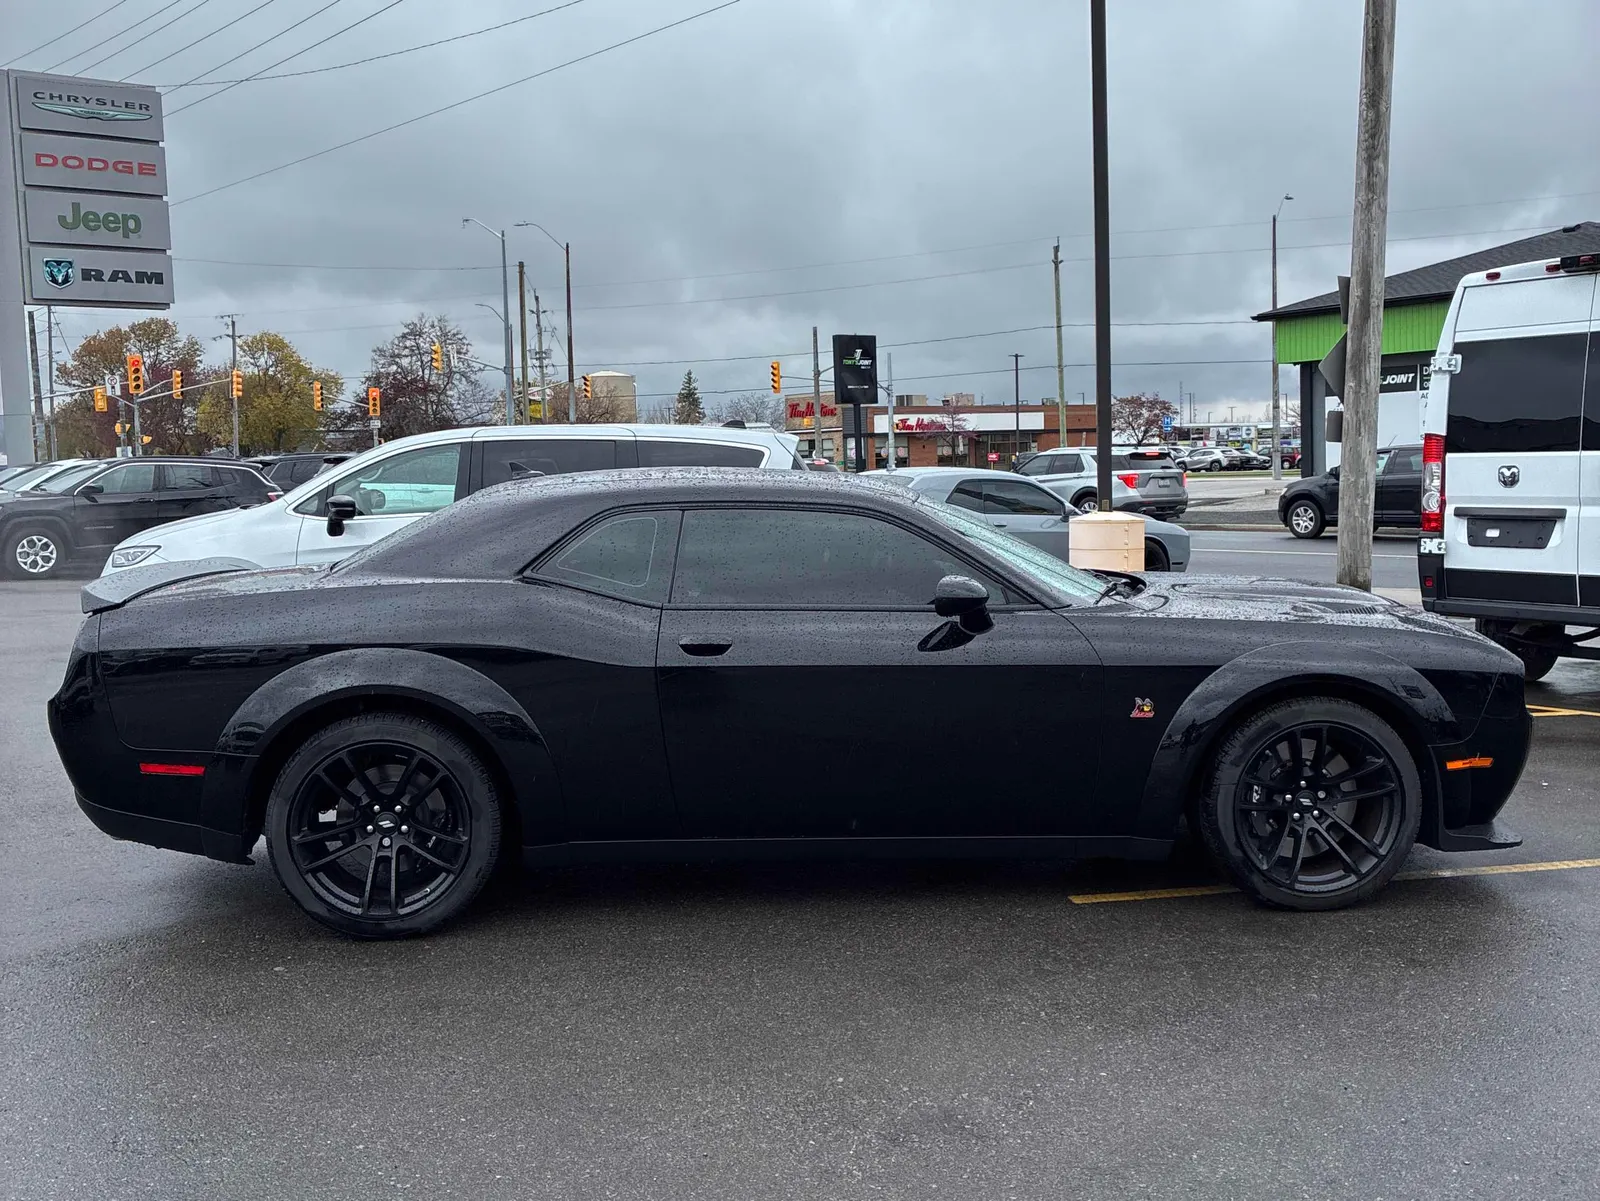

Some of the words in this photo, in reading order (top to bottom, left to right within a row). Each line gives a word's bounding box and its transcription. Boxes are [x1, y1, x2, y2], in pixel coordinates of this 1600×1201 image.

[32, 91, 151, 112] CHRYSLER
[35, 153, 157, 176] DODGE
[57, 202, 141, 238] Jeep
[80, 268, 164, 285] RAM
[1382, 373, 1415, 385] JOINT
[788, 402, 805, 418] Tim
[898, 418, 914, 431] Tim
